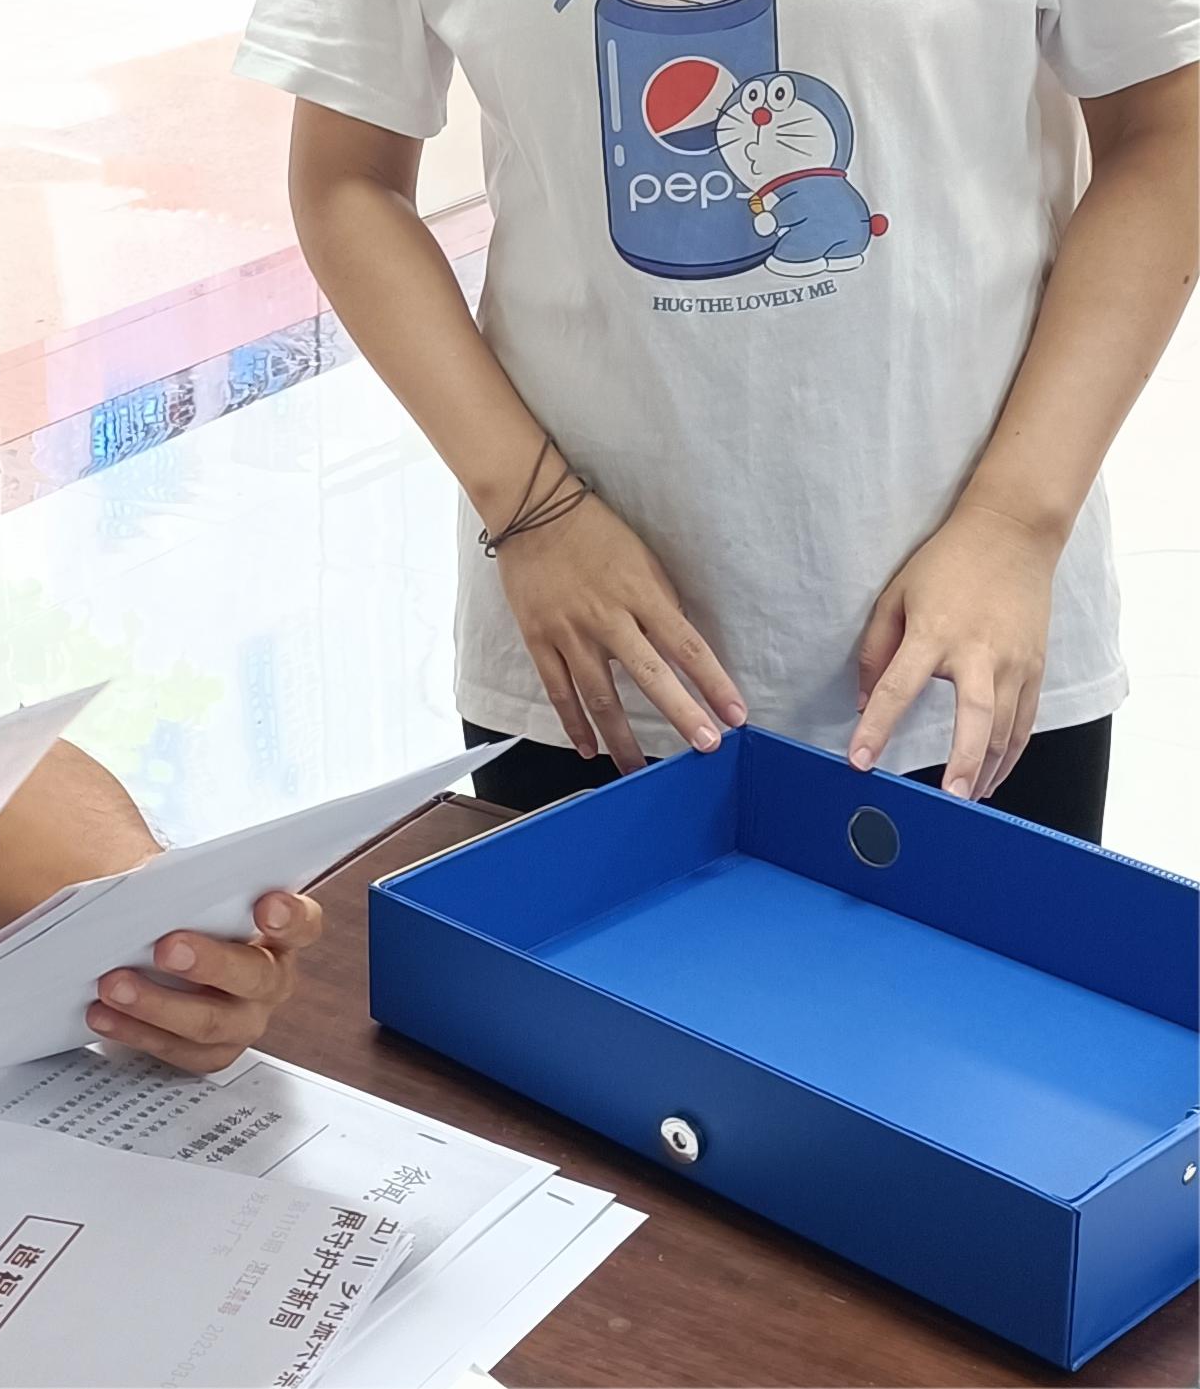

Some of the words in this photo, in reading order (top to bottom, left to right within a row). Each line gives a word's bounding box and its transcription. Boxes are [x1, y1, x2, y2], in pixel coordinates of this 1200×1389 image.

[653, 296, 693, 313] HUG
[696, 298, 734, 313] THE
[736, 288, 805, 311] LOVELY
[807, 279, 837, 297] ME
[269, 1206, 368, 1330] 展守护开新局
